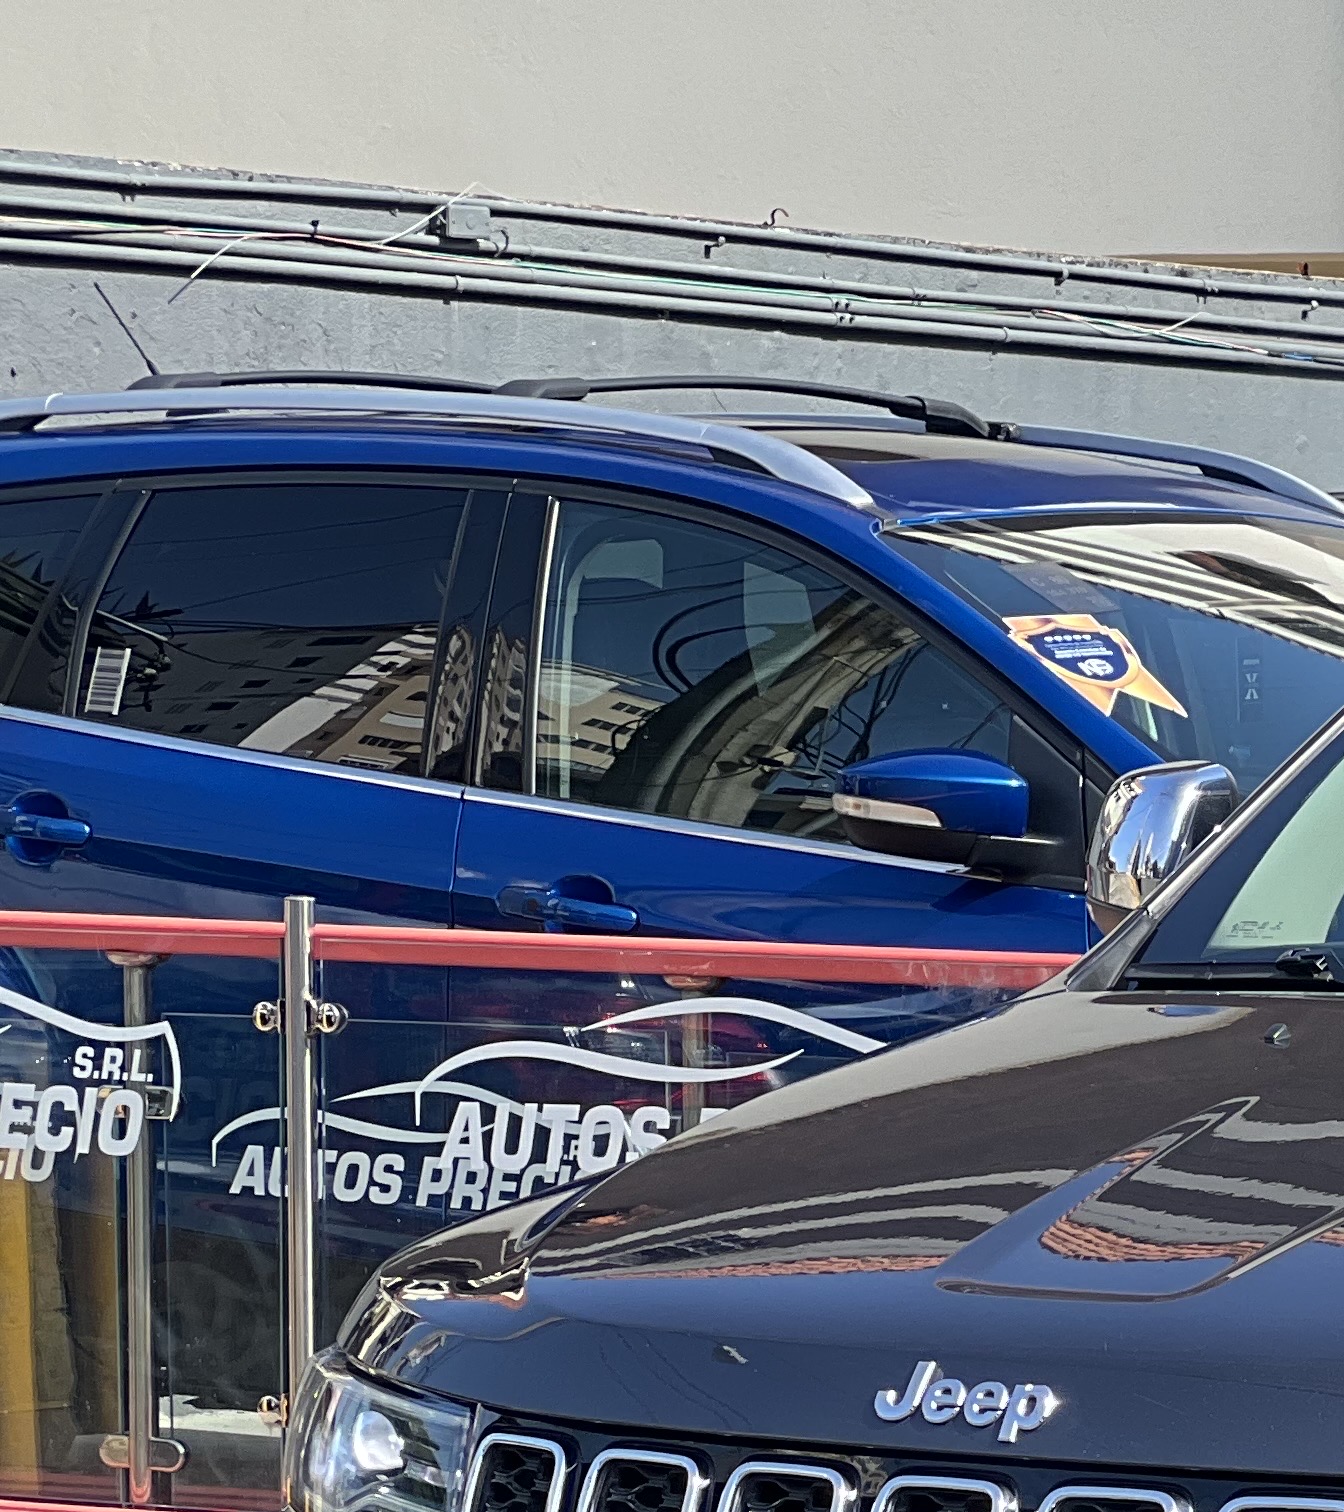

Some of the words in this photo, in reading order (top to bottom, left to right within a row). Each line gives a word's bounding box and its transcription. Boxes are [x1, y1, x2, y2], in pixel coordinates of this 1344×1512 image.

[72, 1045, 154, 1083] S.R.L.
[437, 1100, 671, 1174] AUTOS
[873, 1360, 1062, 1443] Jeep
